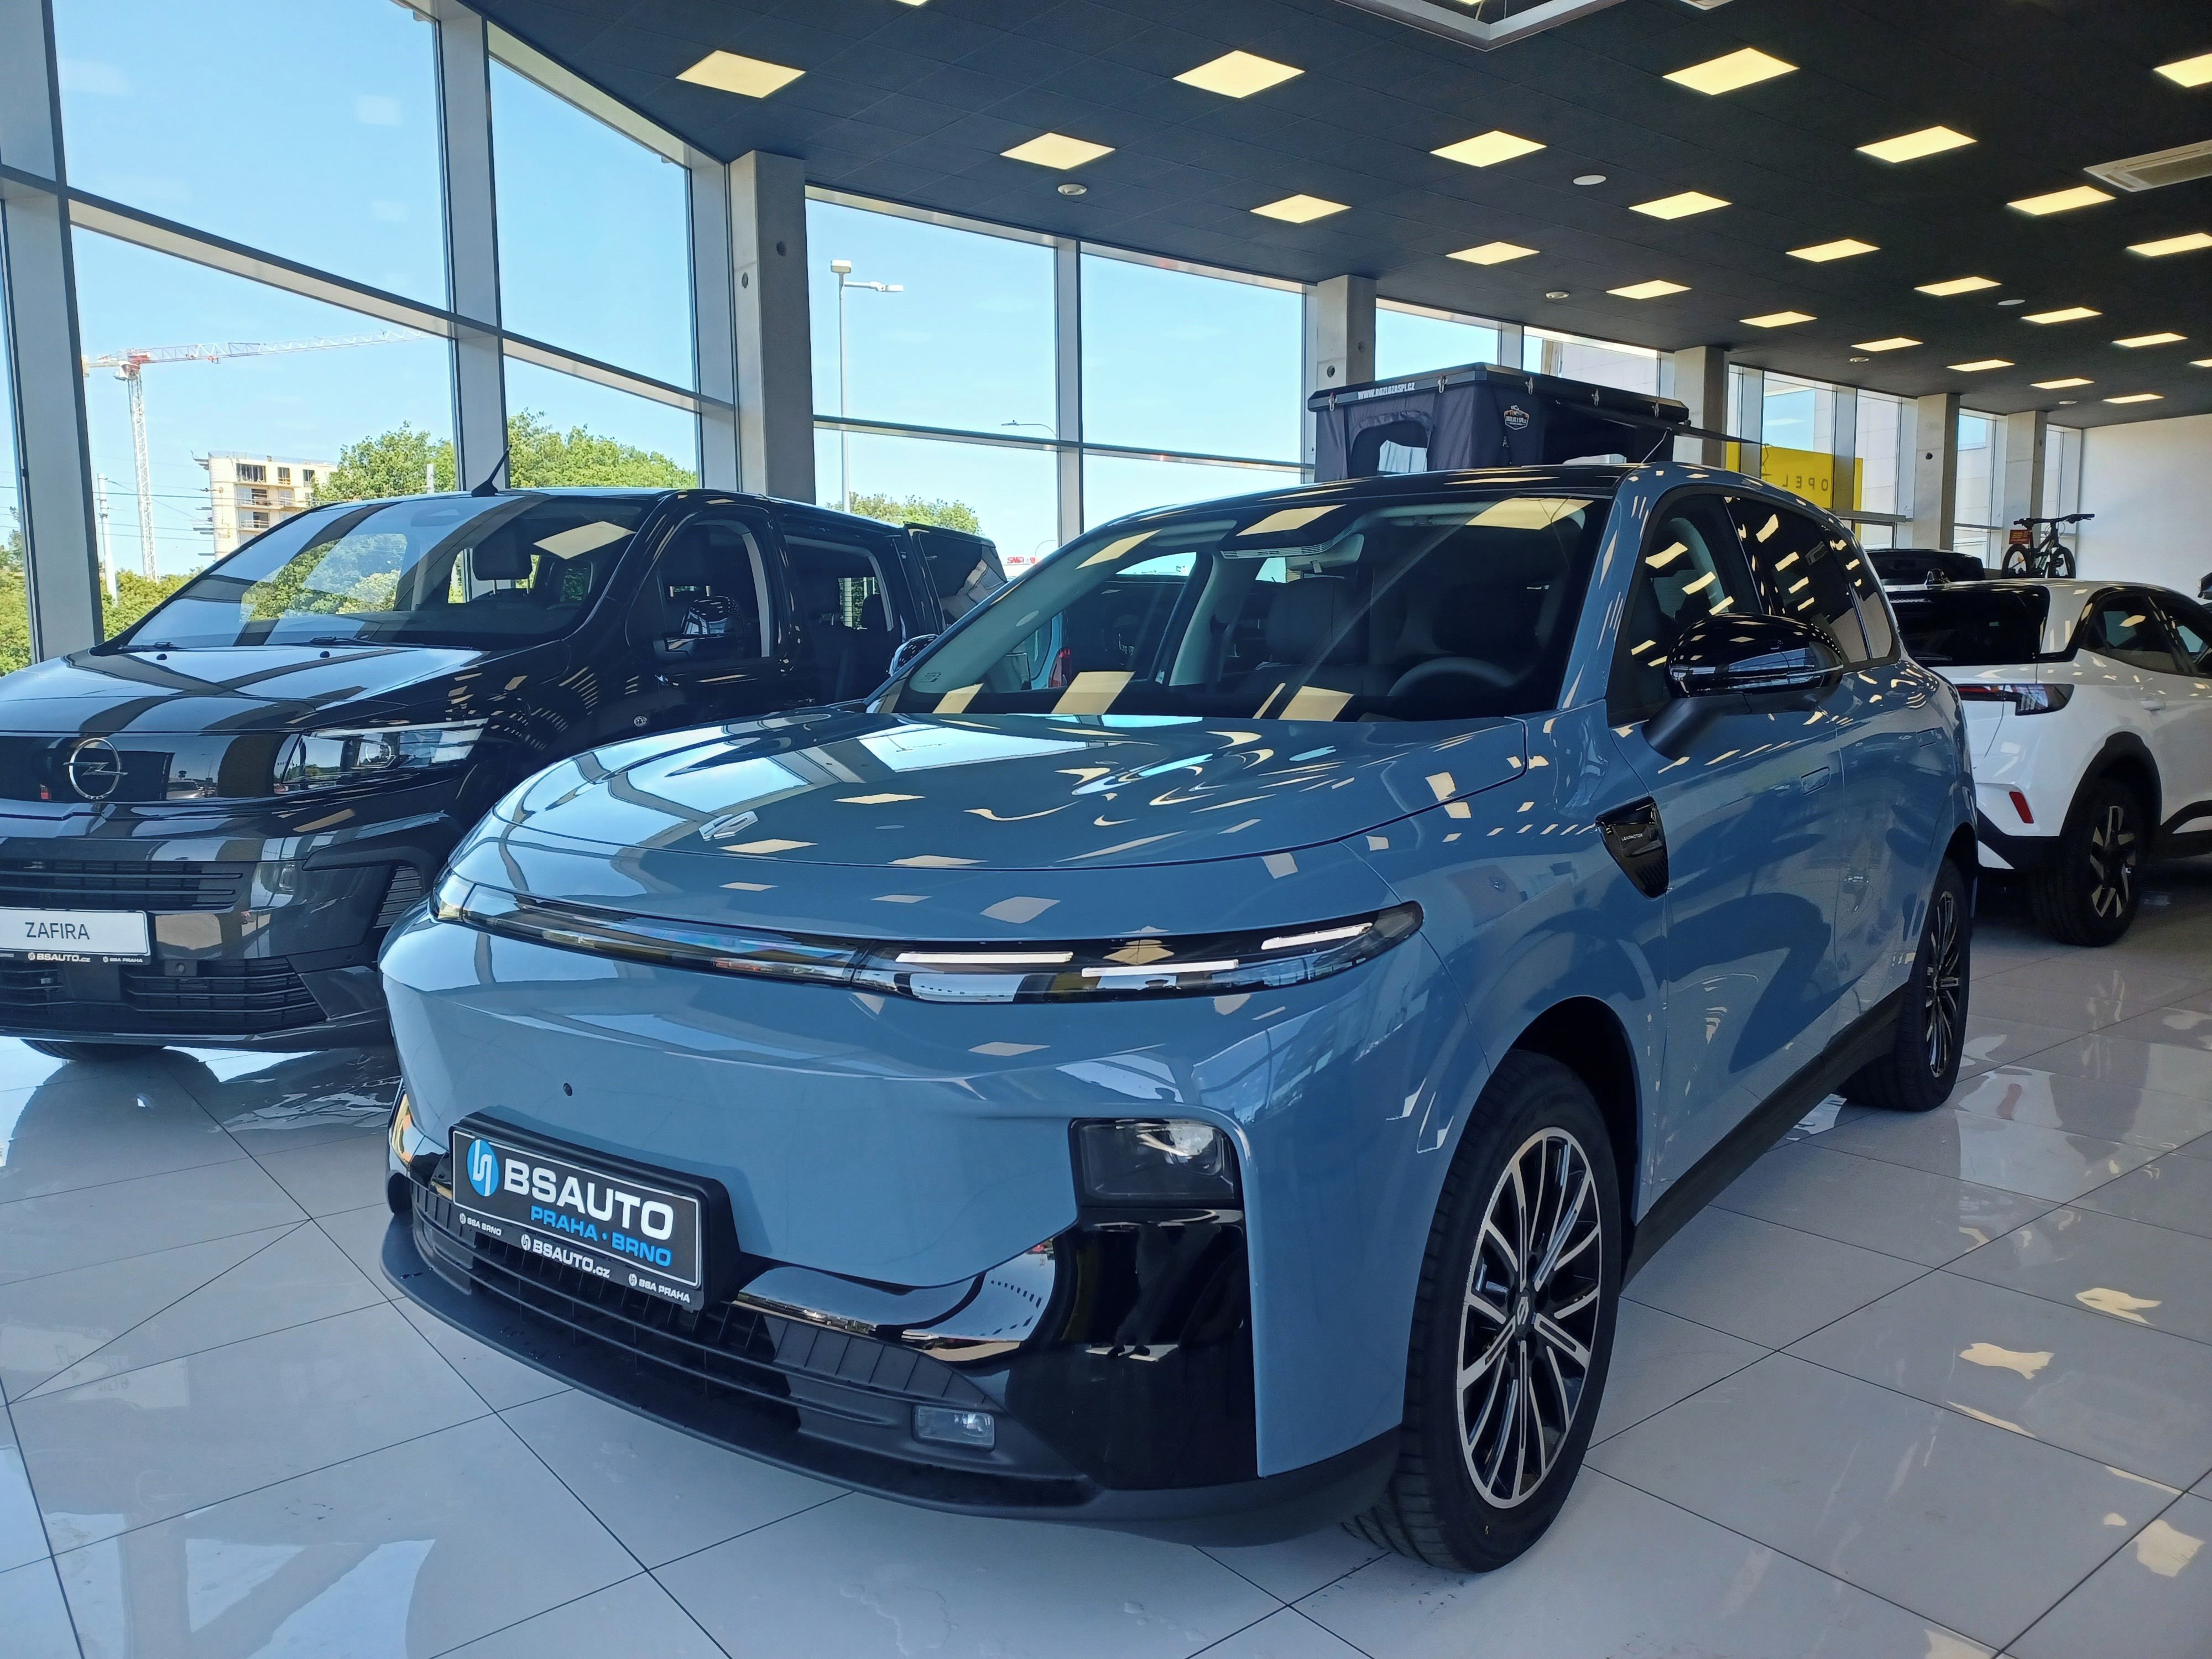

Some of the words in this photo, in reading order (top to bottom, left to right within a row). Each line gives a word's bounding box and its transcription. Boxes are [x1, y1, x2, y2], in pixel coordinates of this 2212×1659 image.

[25, 922, 90, 940] ZAFIRA
[504, 1158, 674, 1240] BSAUTO
[467, 1217, 481, 1228] BSA
[481, 1223, 502, 1236] BRNO
[530, 1205, 598, 1242] PRAHA
[612, 1232, 672, 1267] BRNO
[639, 1279, 656, 1292] BSA
[658, 1285, 690, 1303] PRAHA
